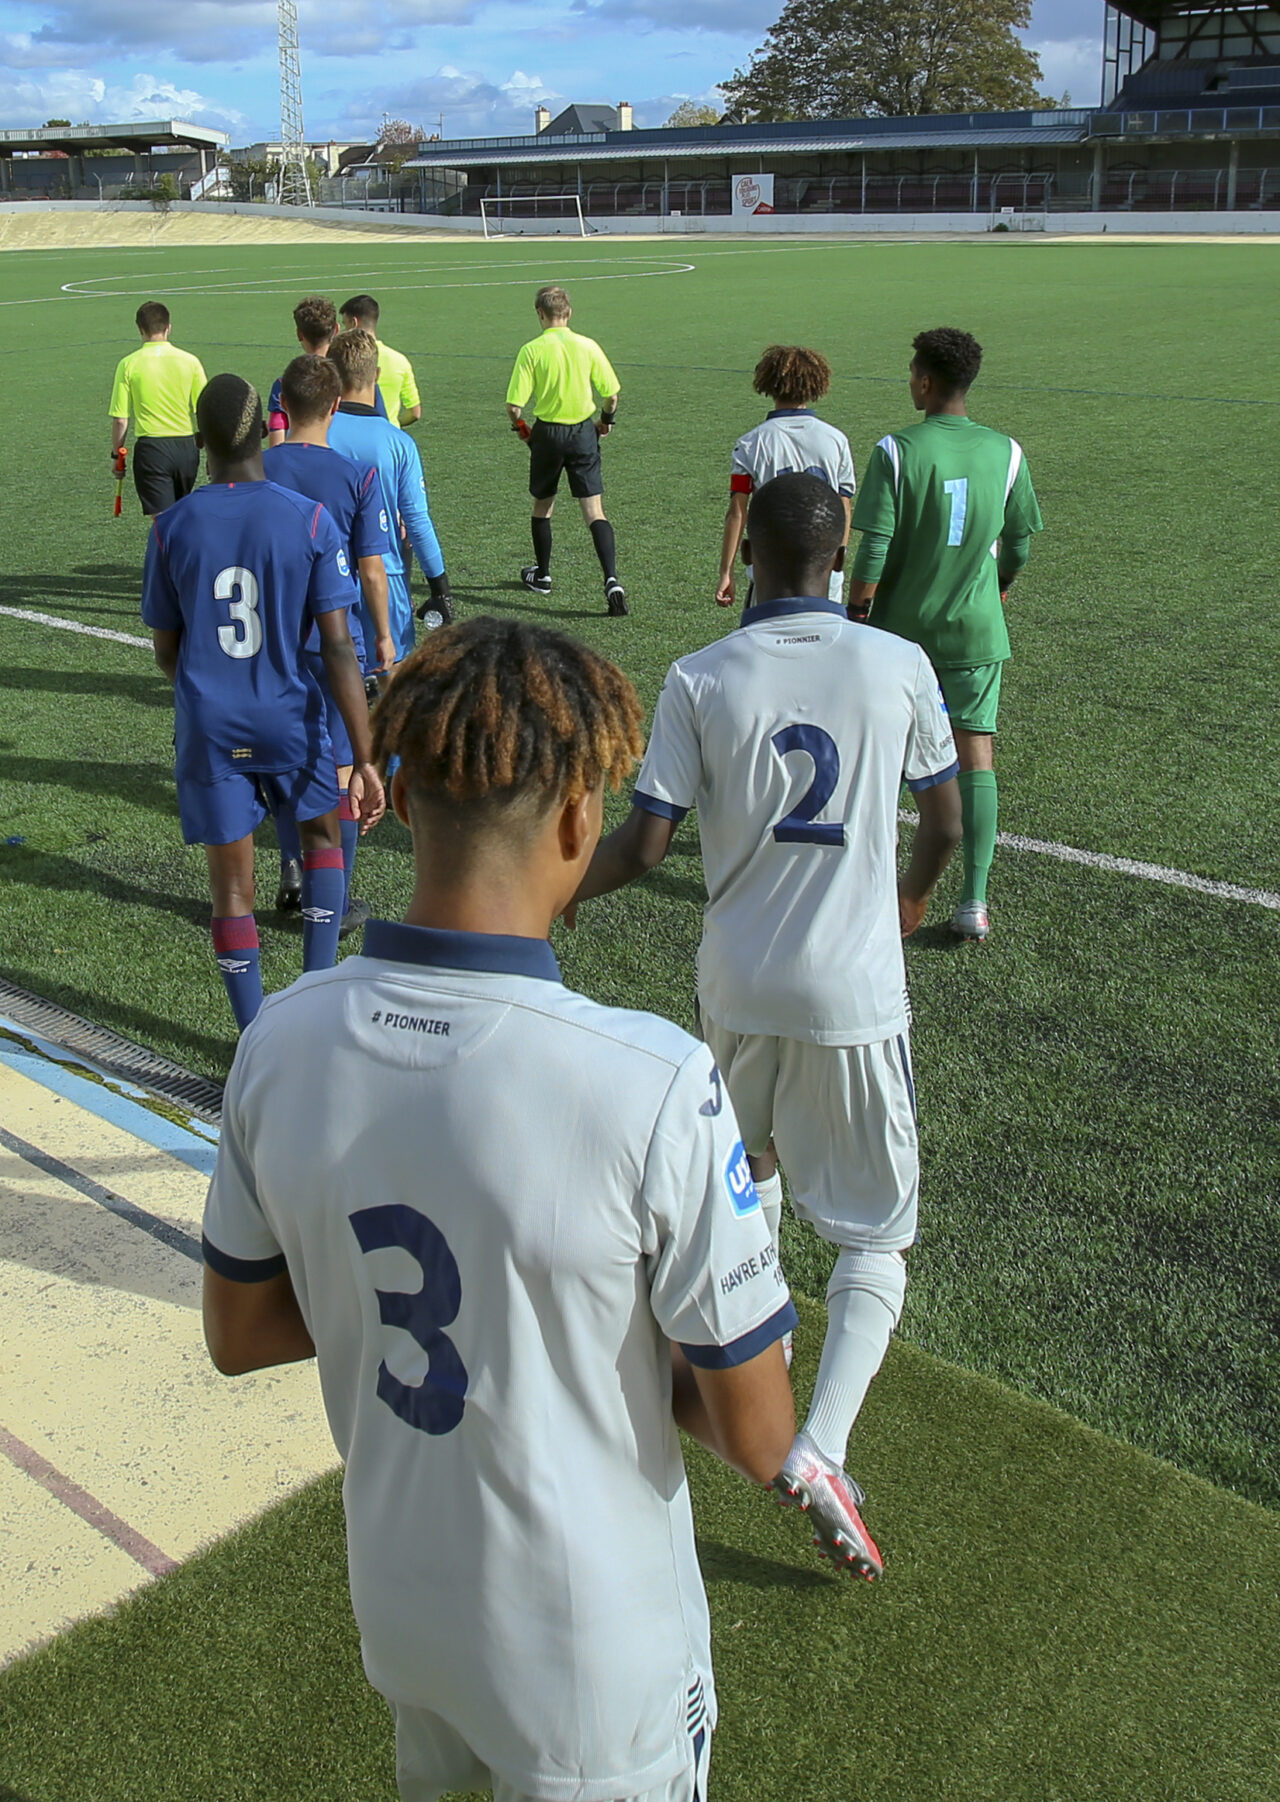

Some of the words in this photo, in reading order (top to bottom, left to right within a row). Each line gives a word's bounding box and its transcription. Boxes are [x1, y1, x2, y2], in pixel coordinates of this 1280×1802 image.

[943, 477, 968, 547] 1
[214, 566, 263, 659] 3
[783, 634, 822, 645] PIONNIER
[771, 723, 845, 847] 2
[384, 1012, 451, 1037] PIONNIER
[720, 1257, 760, 1296] HAVRE
[347, 1203, 469, 1437] 3
